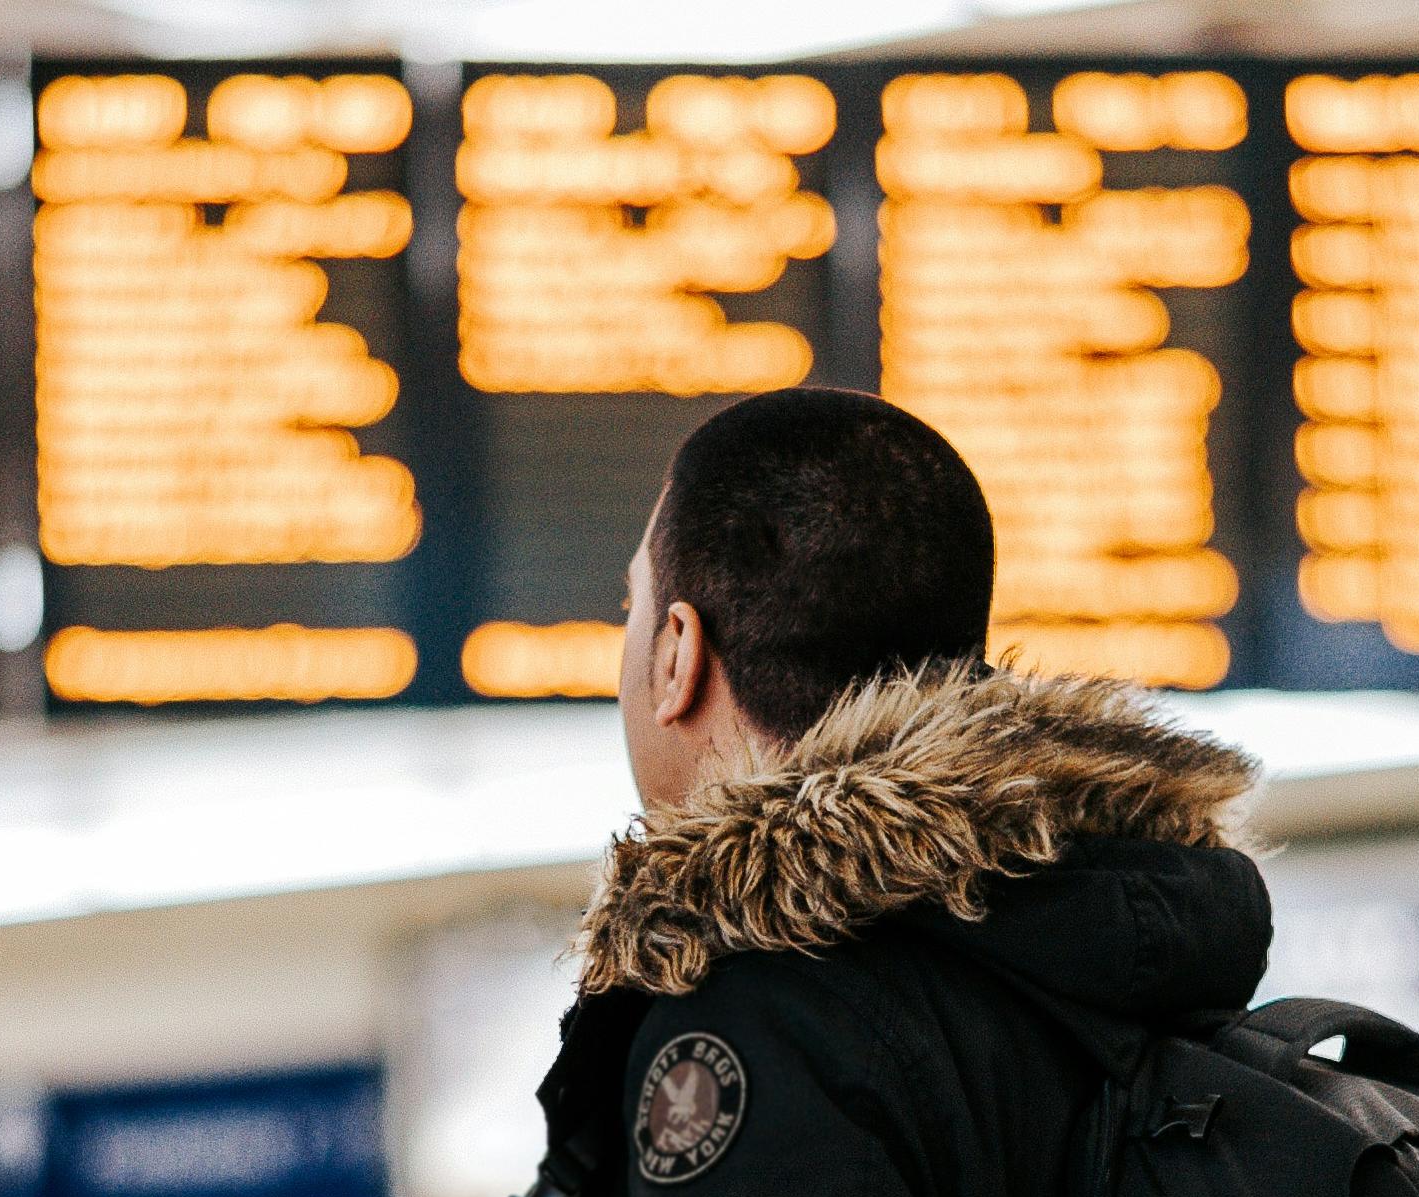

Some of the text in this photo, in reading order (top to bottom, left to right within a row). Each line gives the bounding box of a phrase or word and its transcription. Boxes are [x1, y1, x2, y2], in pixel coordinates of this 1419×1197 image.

[638, 1041, 737, 1128] SCHOTT BROS
[685, 1112, 734, 1165] YORK
